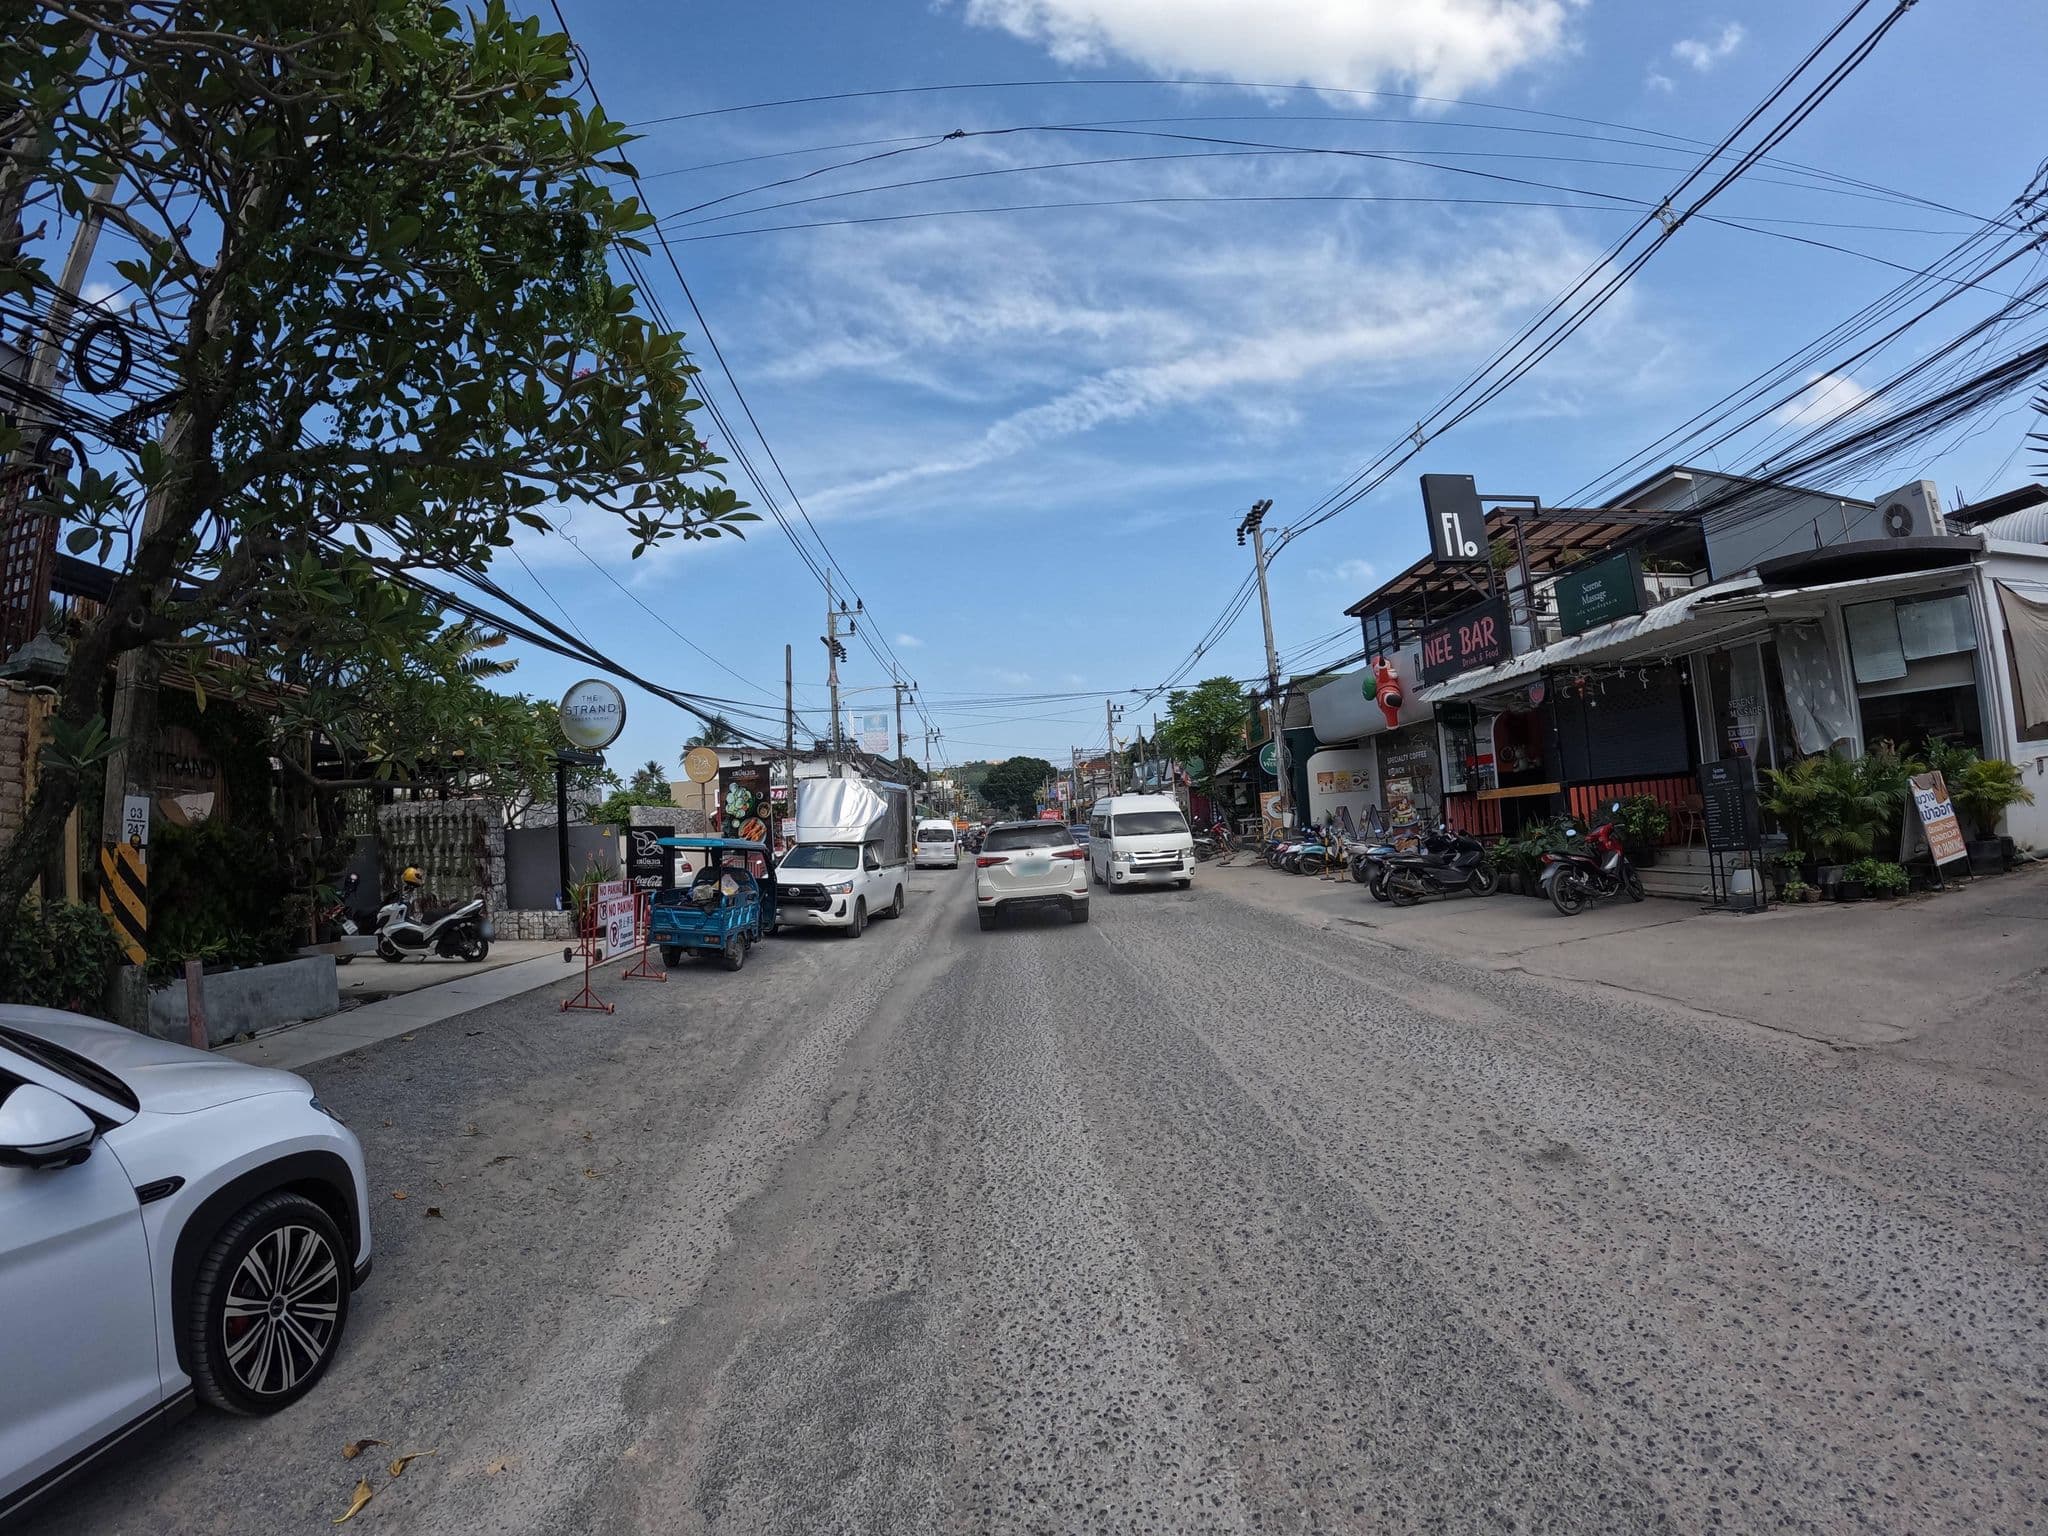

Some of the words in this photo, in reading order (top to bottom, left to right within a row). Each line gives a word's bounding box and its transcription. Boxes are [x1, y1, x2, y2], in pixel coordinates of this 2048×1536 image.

[1441, 512, 1478, 557] Flo
[1581, 580, 1602, 594] Serene
[1581, 591, 1607, 606] Massage
[1424, 633, 1454, 669] NEE
[1458, 616, 1498, 656] BAR
[1462, 655, 1477, 667] Drink
[1485, 647, 1499, 659] Food
[565, 703, 616, 716] STRAND
[1409, 750, 1427, 760] COFFEE
[154, 752, 216, 779] TRAND
[130, 808, 143, 819] 03
[128, 824, 145, 834] 247
[599, 885, 606, 896] NO
[608, 903, 617, 918] NO
